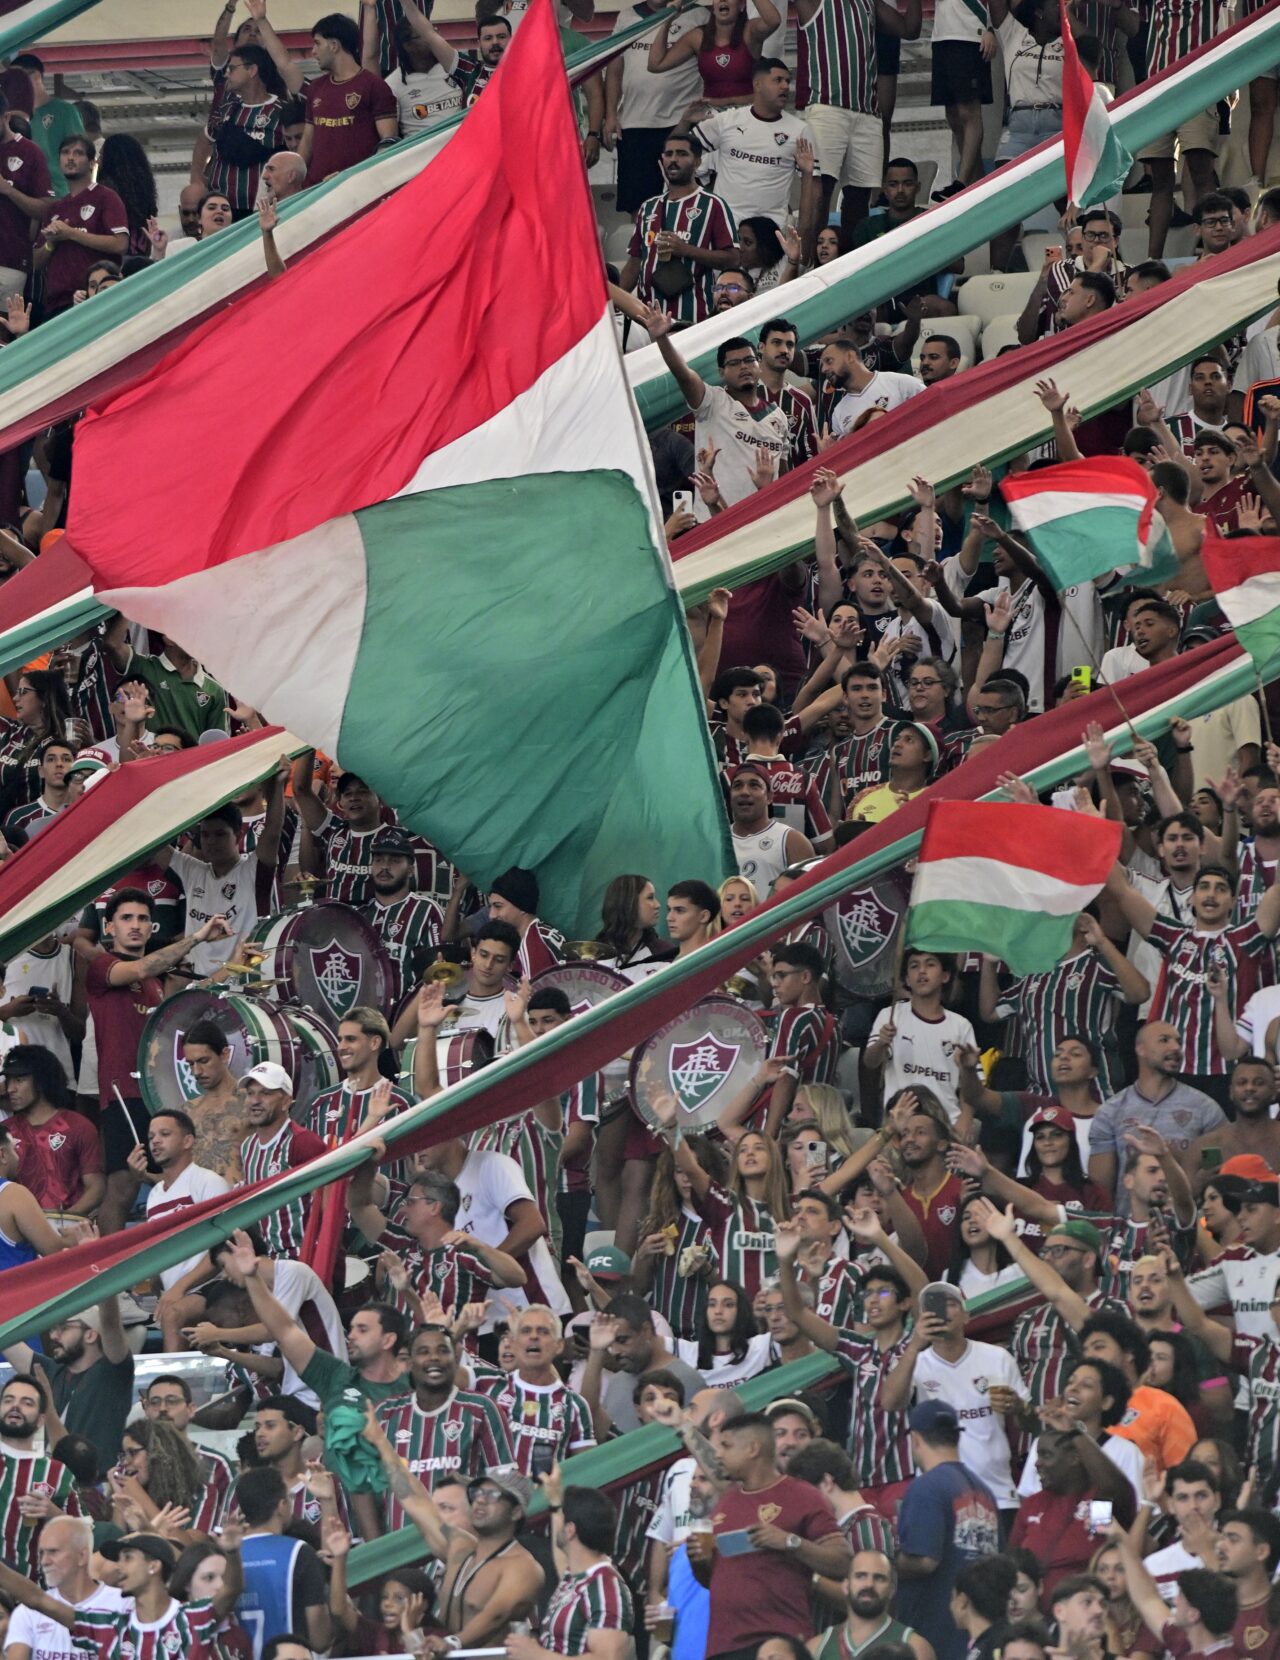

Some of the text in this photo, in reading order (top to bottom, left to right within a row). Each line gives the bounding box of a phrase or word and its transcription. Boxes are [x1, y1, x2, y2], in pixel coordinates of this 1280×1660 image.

[730, 148, 781, 166] SUPERBET
[770, 770, 802, 794] Cola
[330, 859, 373, 875] SUPERB
[588, 1256, 613, 1270] FFC
[409, 1455, 462, 1473] BETANO
